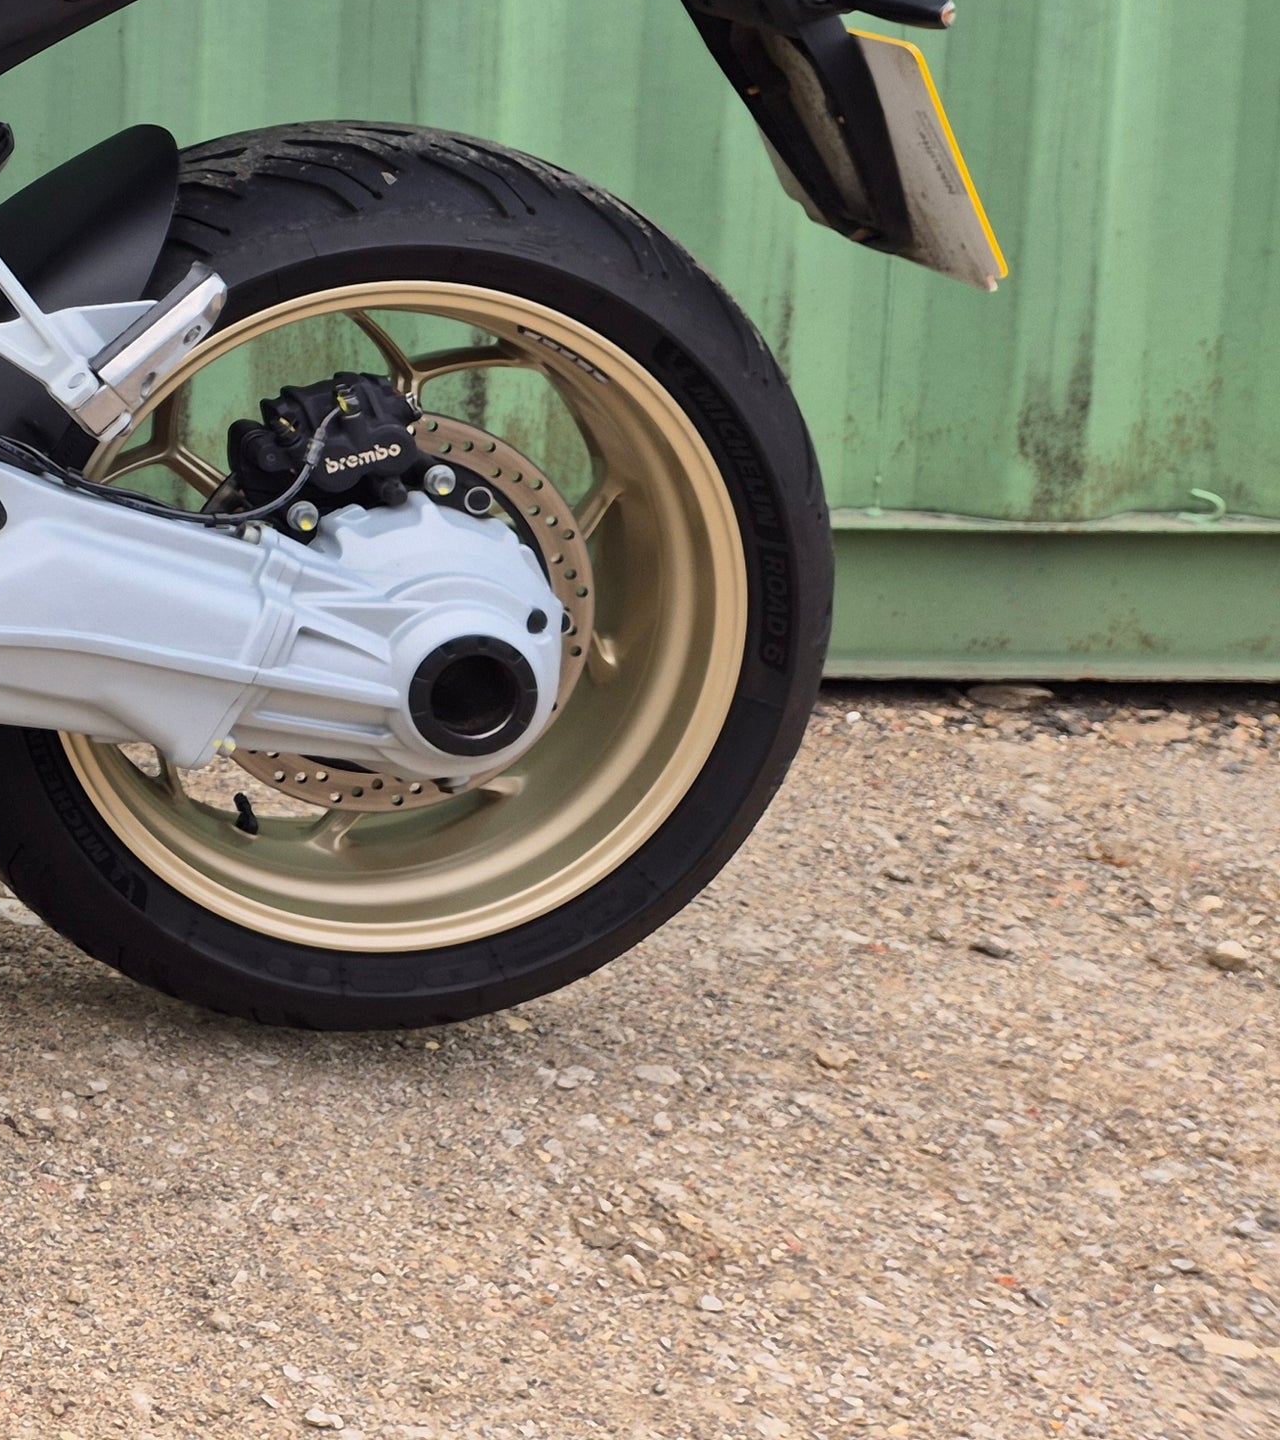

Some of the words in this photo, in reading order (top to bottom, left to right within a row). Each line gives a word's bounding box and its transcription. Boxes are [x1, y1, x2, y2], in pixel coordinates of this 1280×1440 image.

[325, 443, 401, 474] brembo
[689, 381, 779, 530] MICHELIN
[761, 553, 788, 637] ROAD
